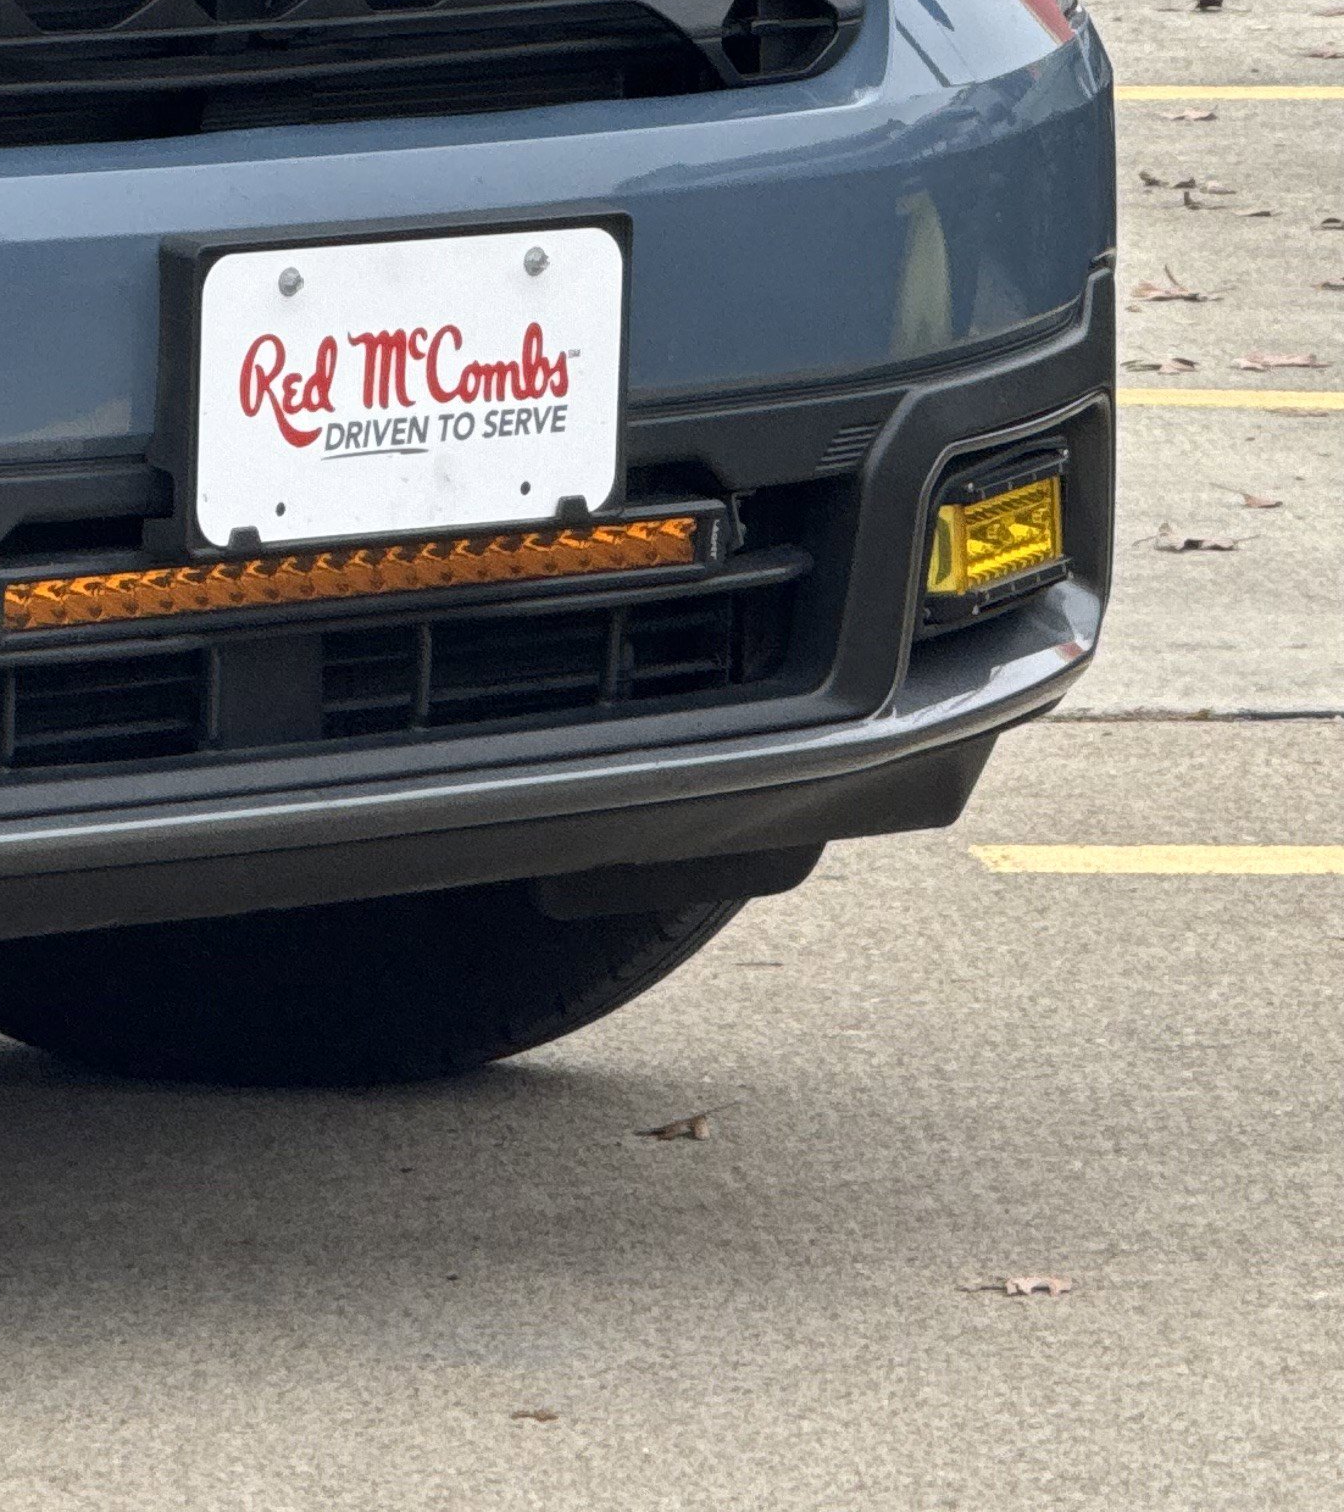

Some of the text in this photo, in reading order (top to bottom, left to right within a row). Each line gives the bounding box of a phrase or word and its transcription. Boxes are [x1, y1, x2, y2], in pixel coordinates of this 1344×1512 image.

[239, 333, 338, 448] Red
[347, 322, 569, 409] McCombs
[324, 404, 568, 452] DRIVEN TO SERVE
